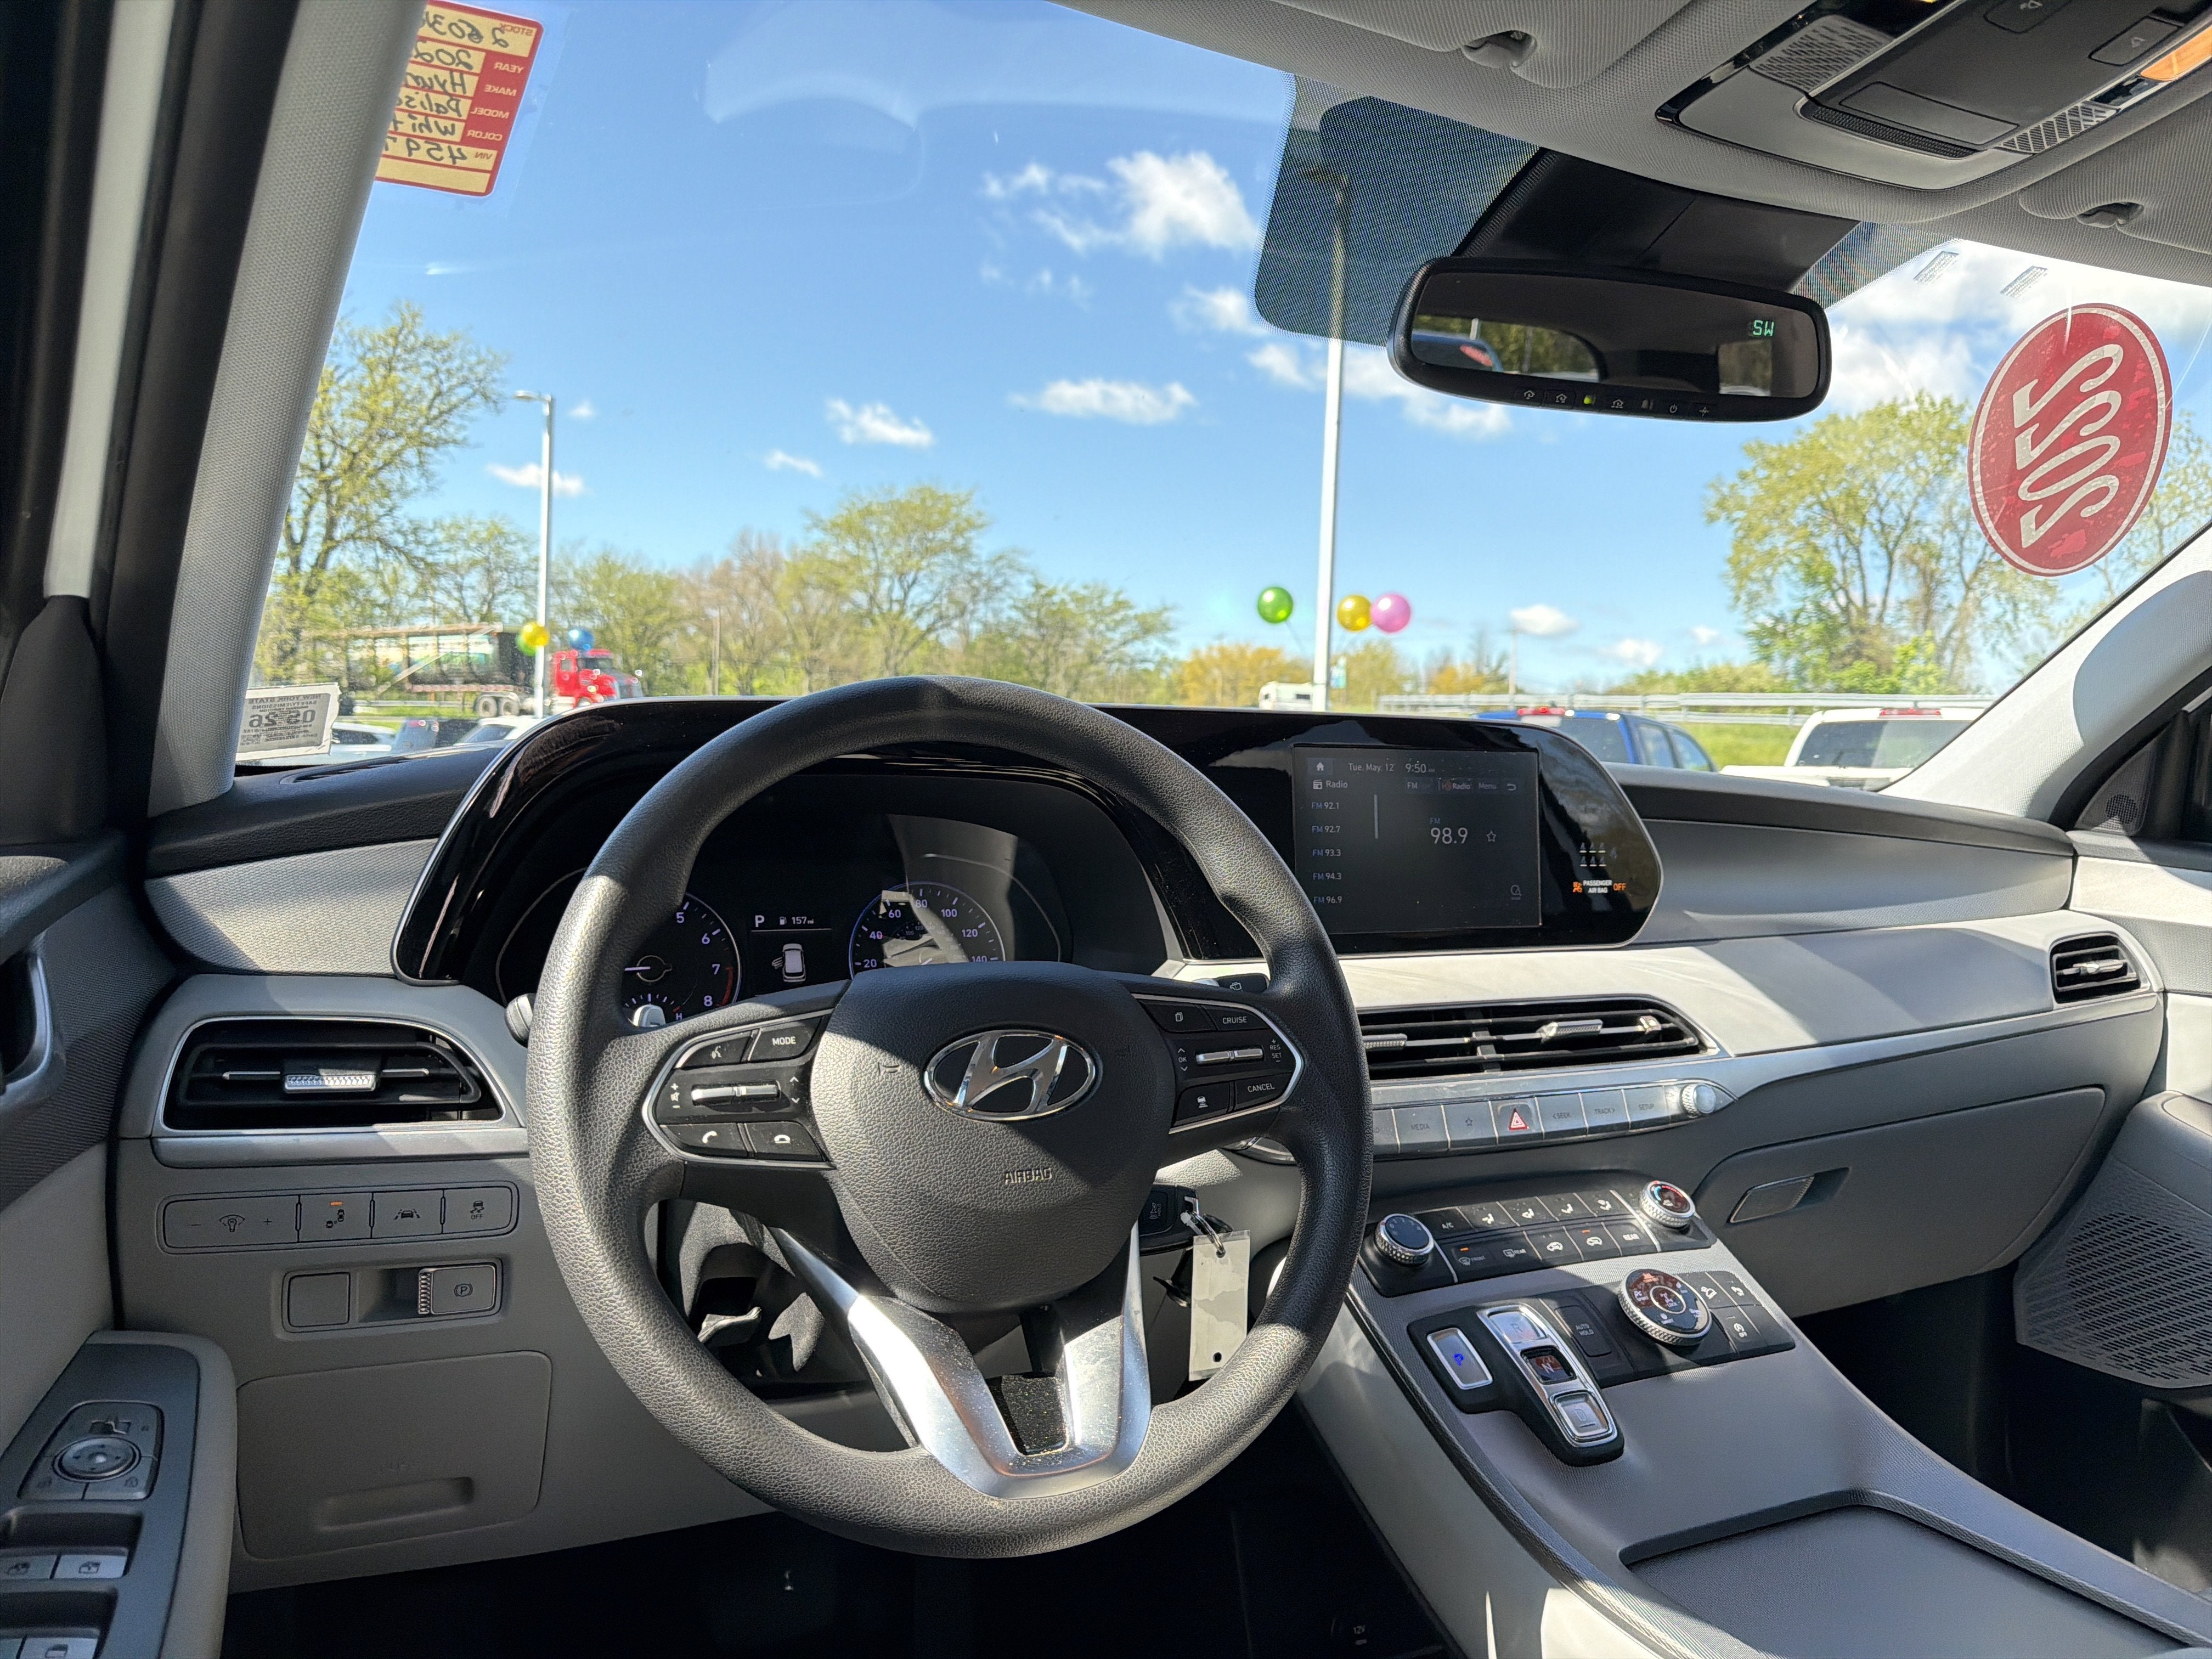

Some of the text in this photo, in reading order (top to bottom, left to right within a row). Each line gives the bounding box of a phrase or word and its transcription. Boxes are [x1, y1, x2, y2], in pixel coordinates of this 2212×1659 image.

[1753, 320, 1774, 336] SW
[1385, 764, 1395, 772] 12
[1405, 763, 1426, 773] 9:50
[1325, 780, 1348, 788] Radio
[1407, 781, 1418, 789] FM
[1431, 827, 1468, 844] 98.9
[1613, 883, 1627, 891] OFF
[915, 899, 928, 909] 80
[676, 912, 685, 924] 5
[888, 910, 901, 918] 60
[941, 909, 957, 917] 100
[755, 915, 765, 928] P
[870, 931, 883, 940] 40
[962, 929, 978, 938] 120
[702, 933, 710, 945] 6
[712, 963, 720, 974] 7
[863, 960, 877, 968] 20
[704, 995, 713, 1007] 8
[1222, 1016, 1248, 1024] CRUISE
[772, 1036, 797, 1046] MODE
[1247, 1083, 1276, 1093] CANCEL
[1004, 1167, 1053, 1185] AIRBAG
[1510, 1323, 1523, 1333] R
[1579, 1328, 1594, 1336] HOLD
[1541, 1362, 1555, 1374] N
